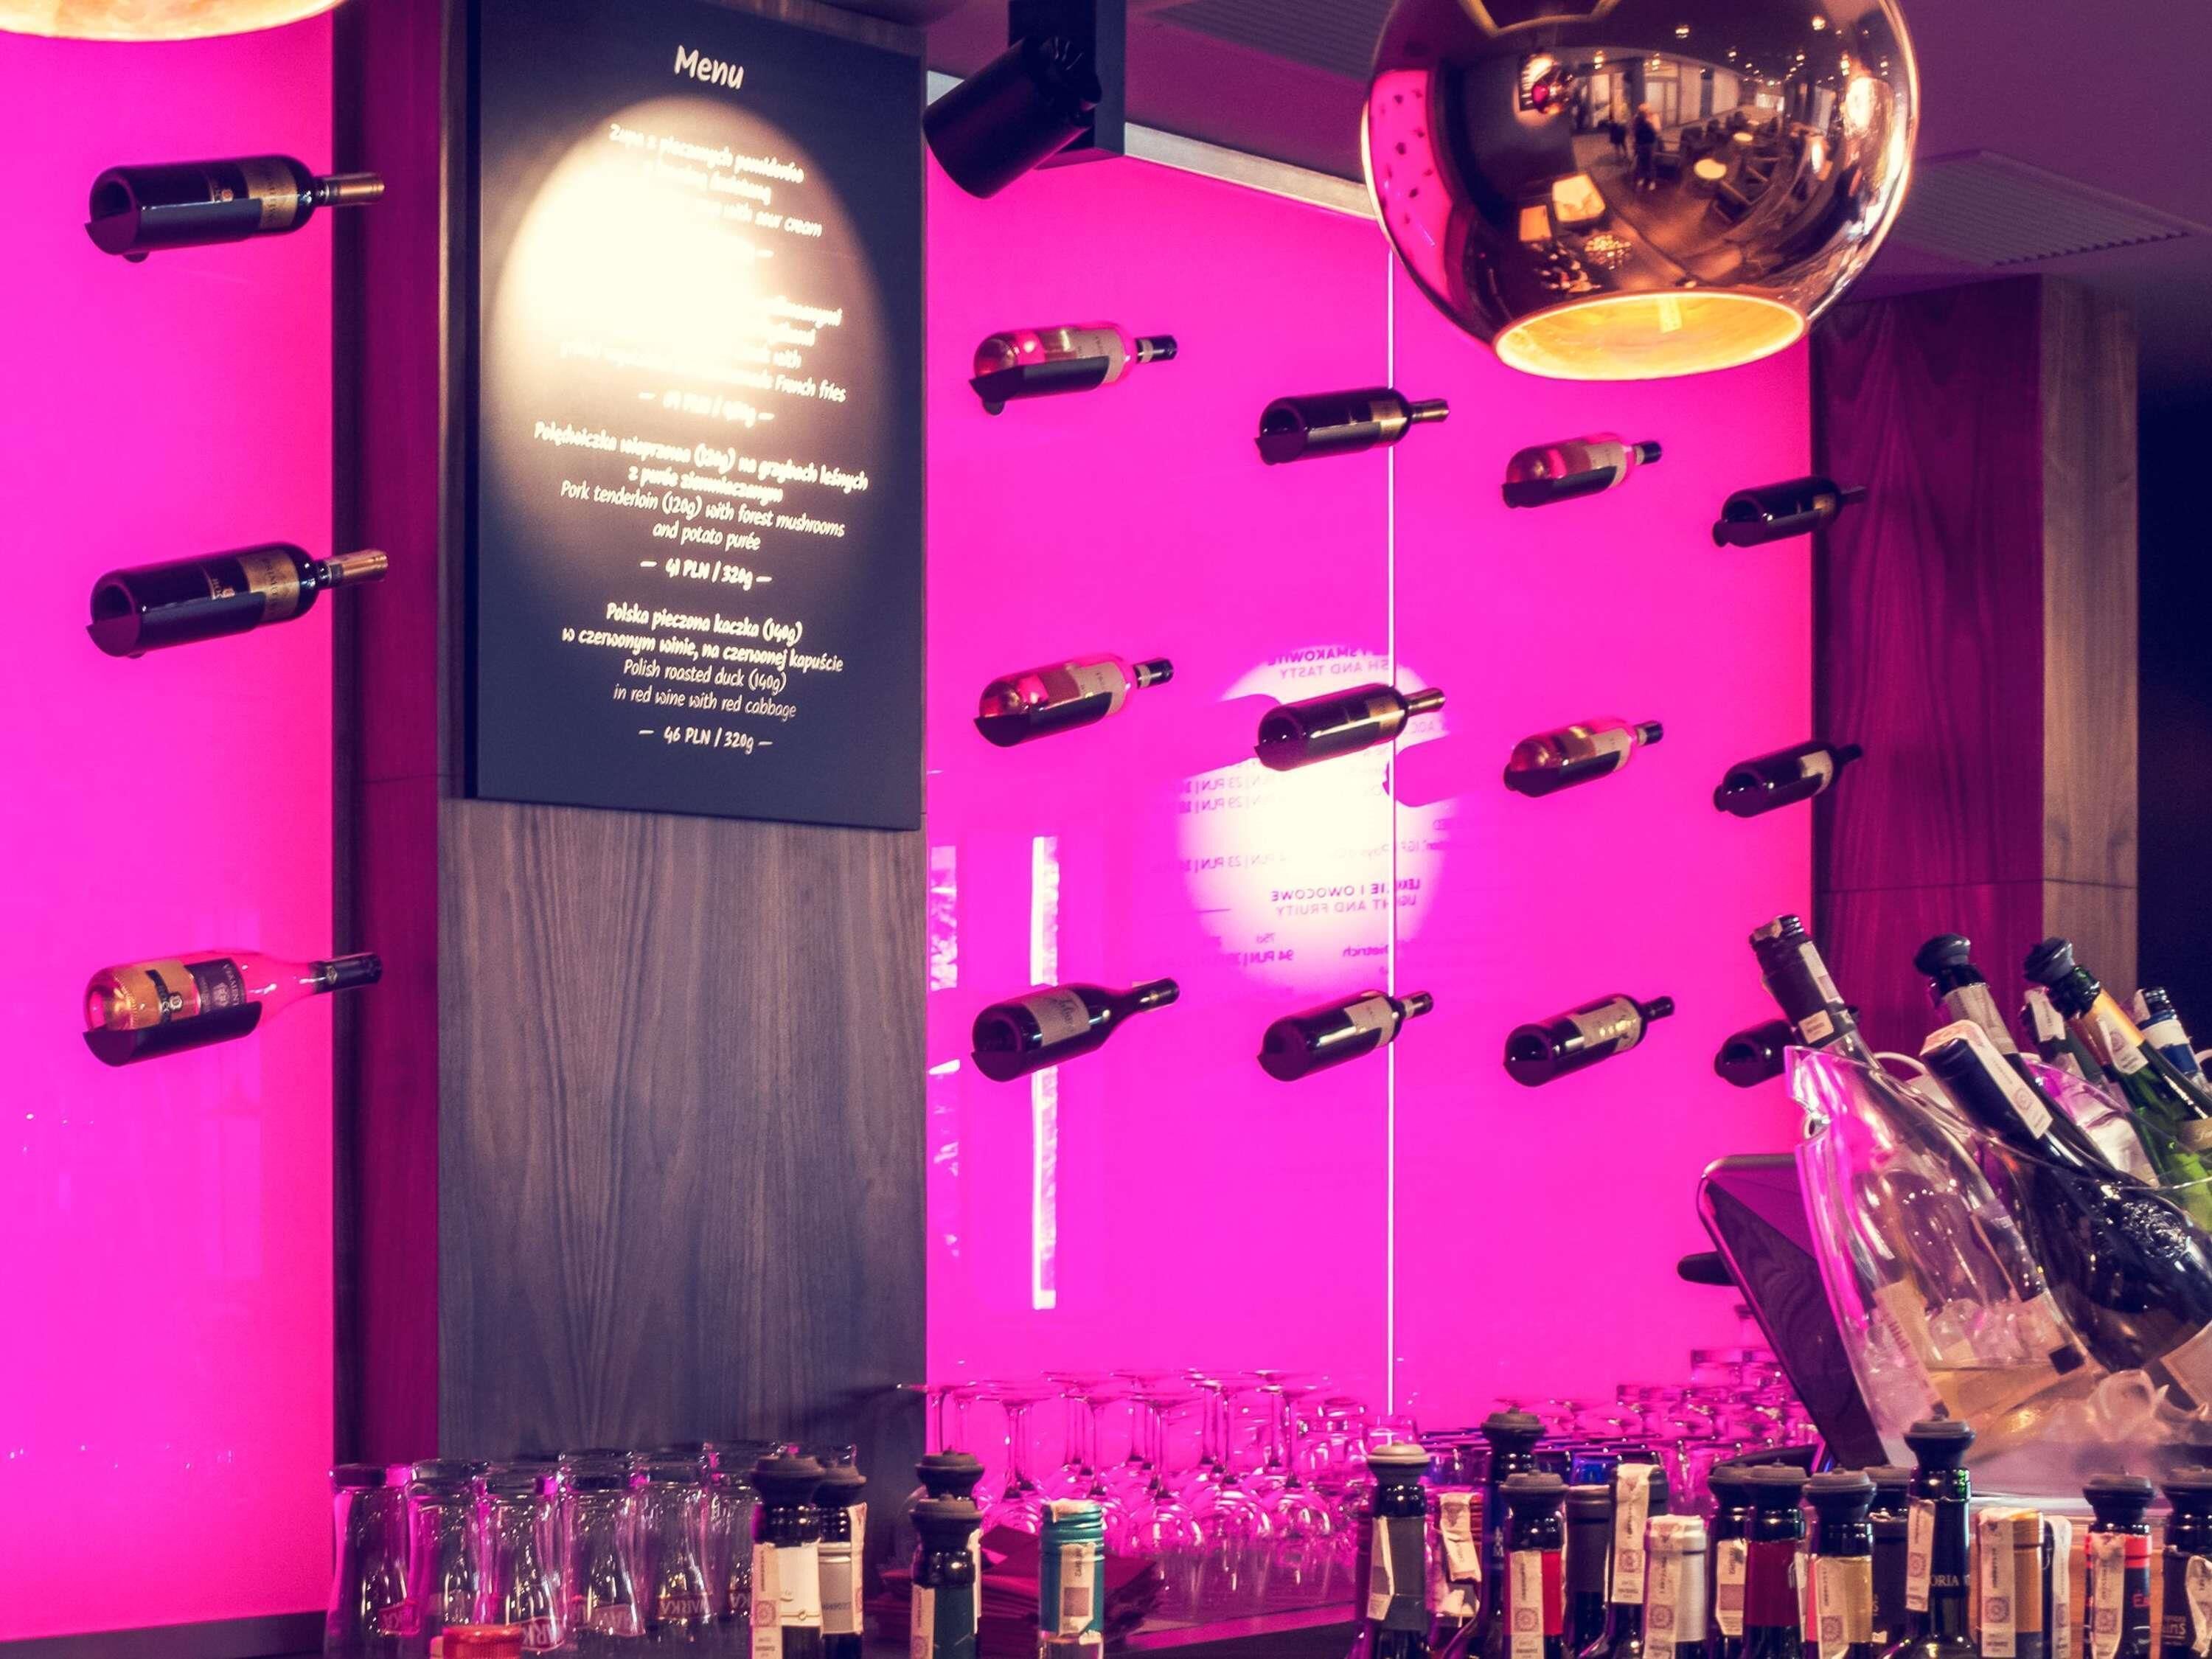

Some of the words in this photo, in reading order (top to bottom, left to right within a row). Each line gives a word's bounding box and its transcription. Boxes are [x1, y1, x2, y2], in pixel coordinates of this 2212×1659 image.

[674, 45, 745, 90] Menu
[785, 217, 822, 237] cream
[818, 378, 846, 403] fries
[758, 459, 817, 484] grzybach
[820, 465, 869, 494] leśnych
[560, 480, 590, 501] Pork
[594, 485, 658, 509] tenderloin
[662, 491, 702, 521] (120g)
[706, 501, 734, 521] with
[738, 504, 774, 527] forest
[776, 512, 845, 538] mushrooms
[653, 521, 679, 540] and
[681, 525, 723, 548] potato
[726, 530, 761, 552] purée
[683, 560, 709, 581] PLN
[722, 563, 754, 591] 320g
[606, 602, 650, 625] Polska
[652, 608, 711, 633] pieczona
[714, 613, 759, 639] kaczka
[762, 617, 803, 645] (140g)
[562, 627, 577, 642] w
[579, 629, 655, 656] czerwonym
[660, 635, 699, 662] winie,
[702, 641, 720, 658] na
[723, 645, 789, 672] czerwonej
[789, 648, 845, 674] kapuście
[624, 658, 662, 679] Polish
[664, 664, 712, 686] roasted
[714, 668, 745, 688] duck
[748, 672, 787, 695] (140g)
[613, 684, 627, 700] in
[630, 686, 652, 704] red
[655, 690, 686, 708] wine
[689, 693, 718, 712] with
[721, 695, 742, 713] red
[745, 698, 797, 721] cabbage
[664, 726, 681, 744] 46
[685, 728, 710, 745] PLN
[724, 731, 754, 755] 320g
